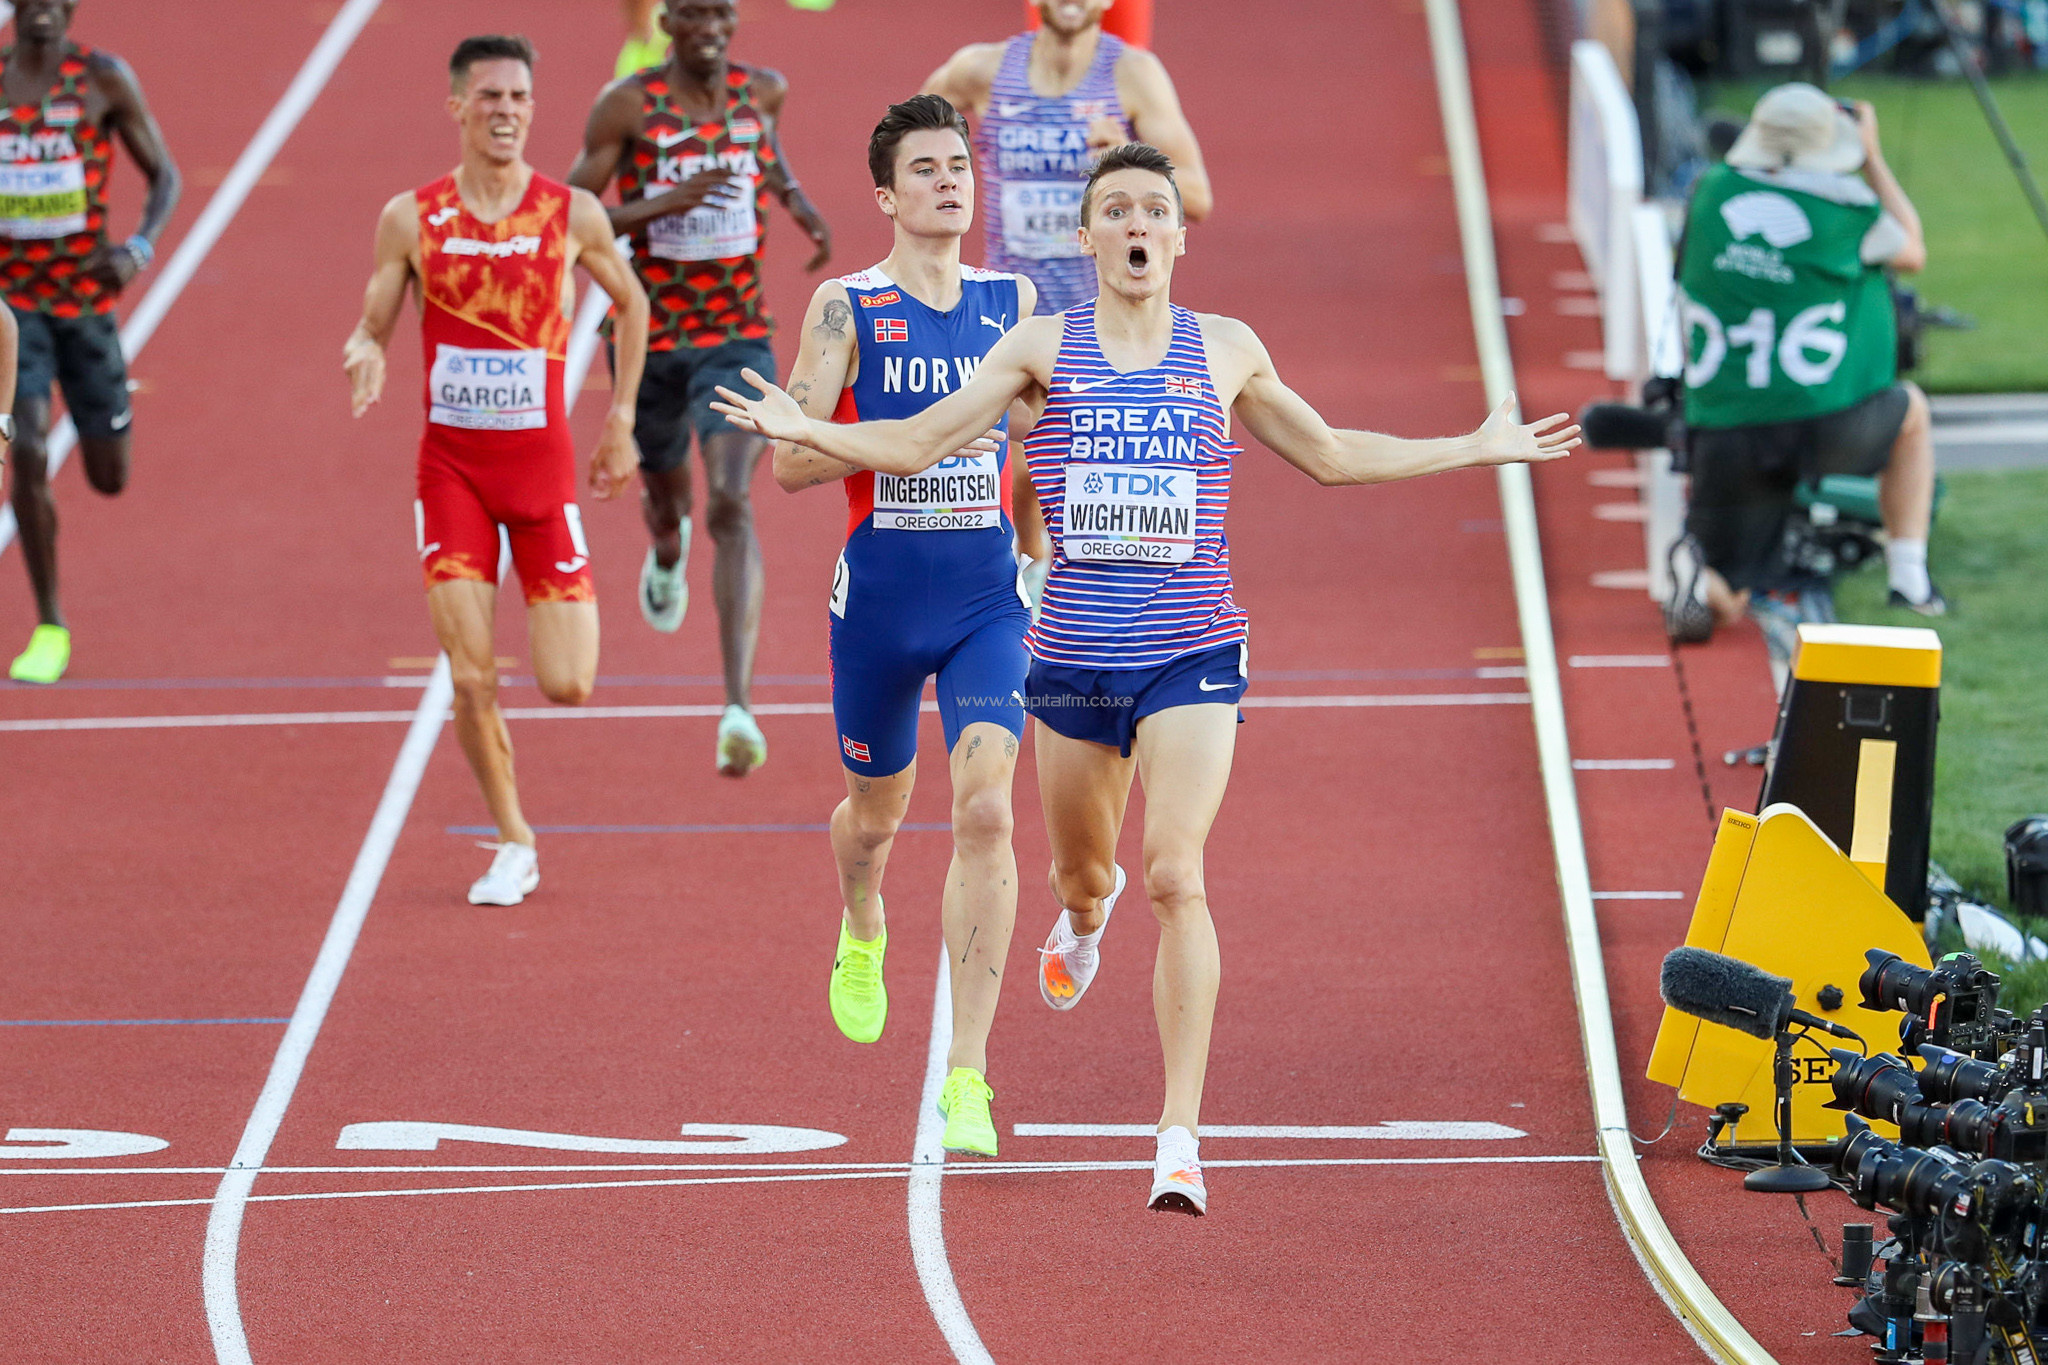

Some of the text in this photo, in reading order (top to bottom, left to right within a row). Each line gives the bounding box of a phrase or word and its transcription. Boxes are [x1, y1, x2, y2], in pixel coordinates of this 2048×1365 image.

[0, 132, 78, 160] ENYA
[998, 128, 1092, 152] GREA
[466, 356, 526, 376] TDK
[883, 356, 981, 394] NORW
[441, 383, 534, 406] GARCÍA
[1070, 408, 1198, 433] GREAT
[1070, 436, 1197, 462] BRITAIN
[879, 474, 996, 504] INGEBRIGTSEN
[1103, 473, 1177, 498] TDK
[894, 514, 983, 529] OREGON22
[1070, 503, 1189, 535] WIGHTMAN
[1081, 542, 1172, 558] OREGON22
[1727, 817, 1752, 830] SEIKO
